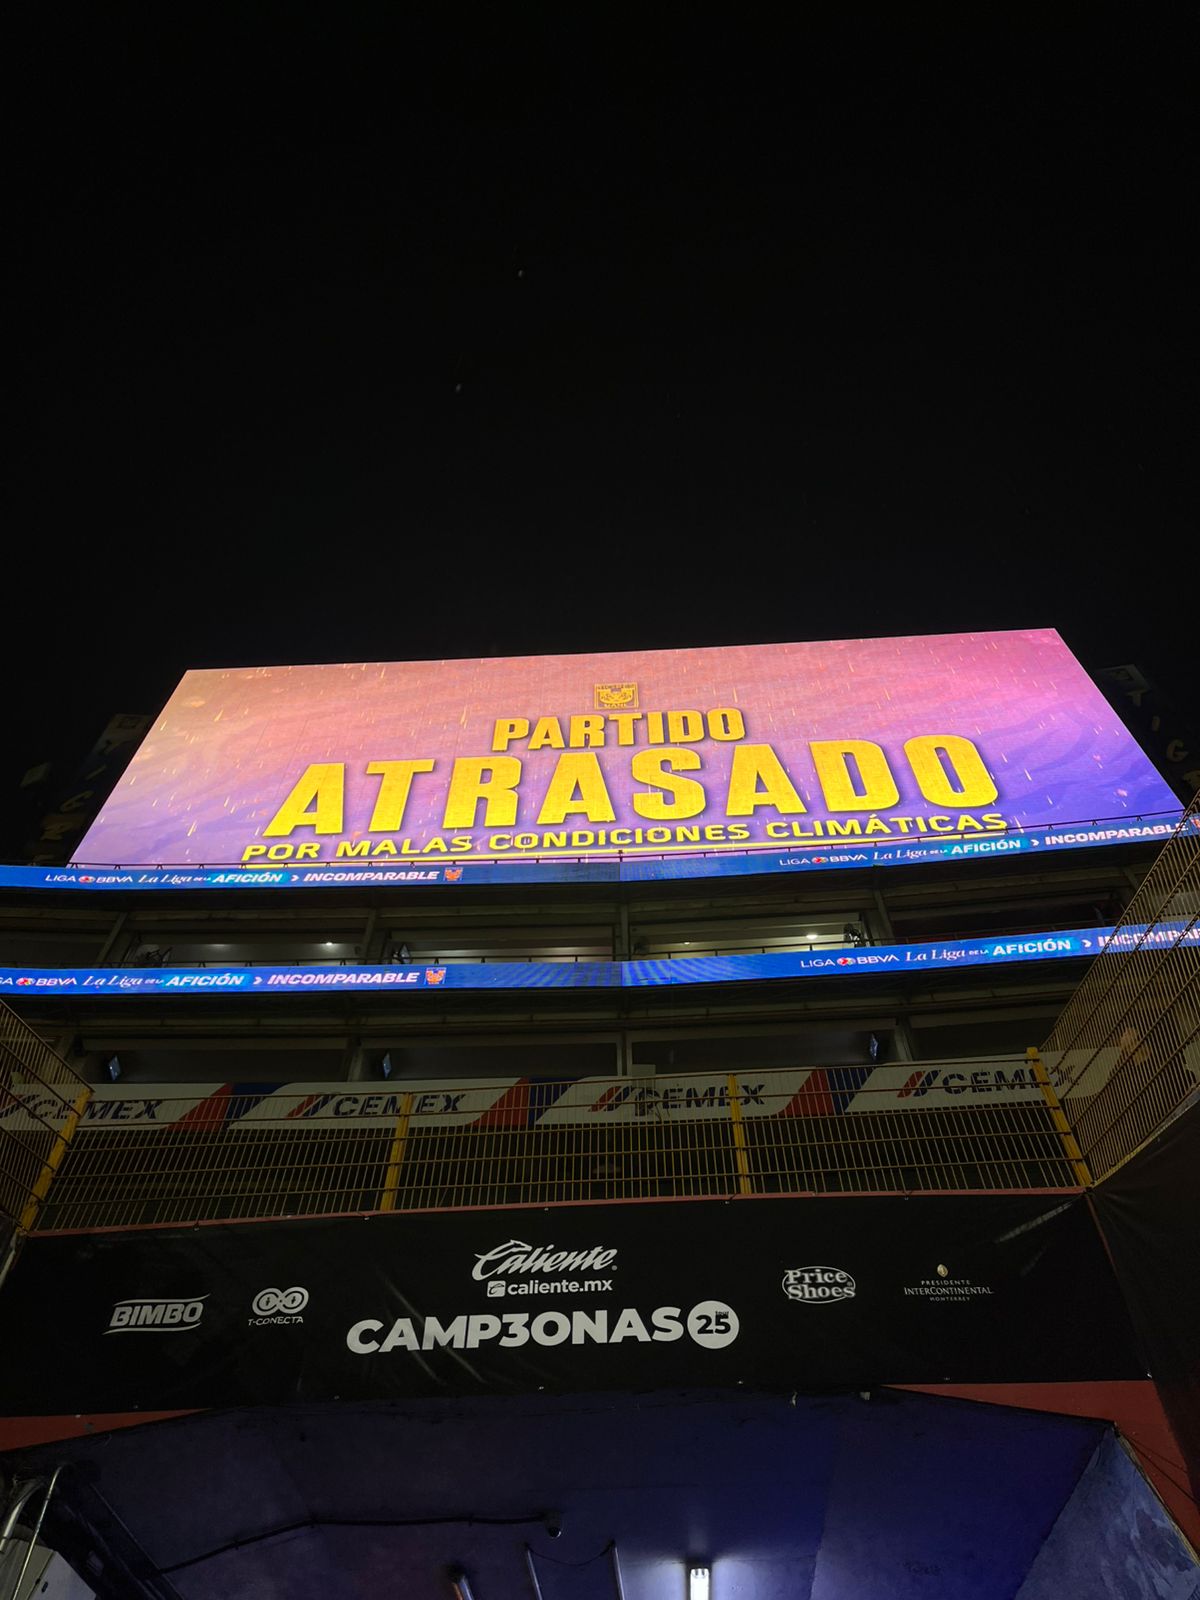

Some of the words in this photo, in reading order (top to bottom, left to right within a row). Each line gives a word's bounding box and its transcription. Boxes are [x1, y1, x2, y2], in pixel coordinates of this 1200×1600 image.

[491, 707, 747, 752] PARTIDO
[262, 733, 999, 838] ATRASADO
[241, 843, 321, 862] POR
[335, 835, 473, 858] MALAS
[488, 823, 749, 851] CONDICIONES
[766, 813, 1008, 839] CLIMÁTICAS
[779, 857, 811, 866] LIGA
[829, 855, 868, 864] BBVA
[873, 851, 893, 861] La
[896, 849, 928, 861] Liga
[951, 838, 1021, 855] AFICIÓN
[1045, 822, 1189, 845] INCOMPARABLE
[45, 874, 76, 883] LIGA
[96, 875, 133, 884] BBVA
[138, 874, 159, 884] La
[160, 874, 193, 885] Liga
[212, 872, 284, 884] AFICIÓN
[303, 871, 440, 882] INCOMPARABLE
[800, 957, 836, 968] LIGA
[857, 954, 899, 965] BBVA
[905, 951, 927, 962] La
[931, 949, 966, 961] Liga
[992, 938, 1071, 957] AFICIÓN
[35, 977, 78, 986] BBVA
[82, 975, 106, 987] La
[107, 975, 142, 988] Liga
[165, 972, 245, 987] AFICIÓN
[267, 971, 420, 985] INCOMPARABLE
[471, 1239, 618, 1281] Caliente
[507, 1279, 613, 1295] caliente.mx
[784, 1268, 848, 1285] Price
[787, 1283, 856, 1300] Shoes
[109, 1302, 204, 1327] BIMBO
[247, 1316, 304, 1327] T-CONECTA
[346, 1306, 685, 1355] CAMP3ONAS
[695, 1314, 731, 1335] 25
